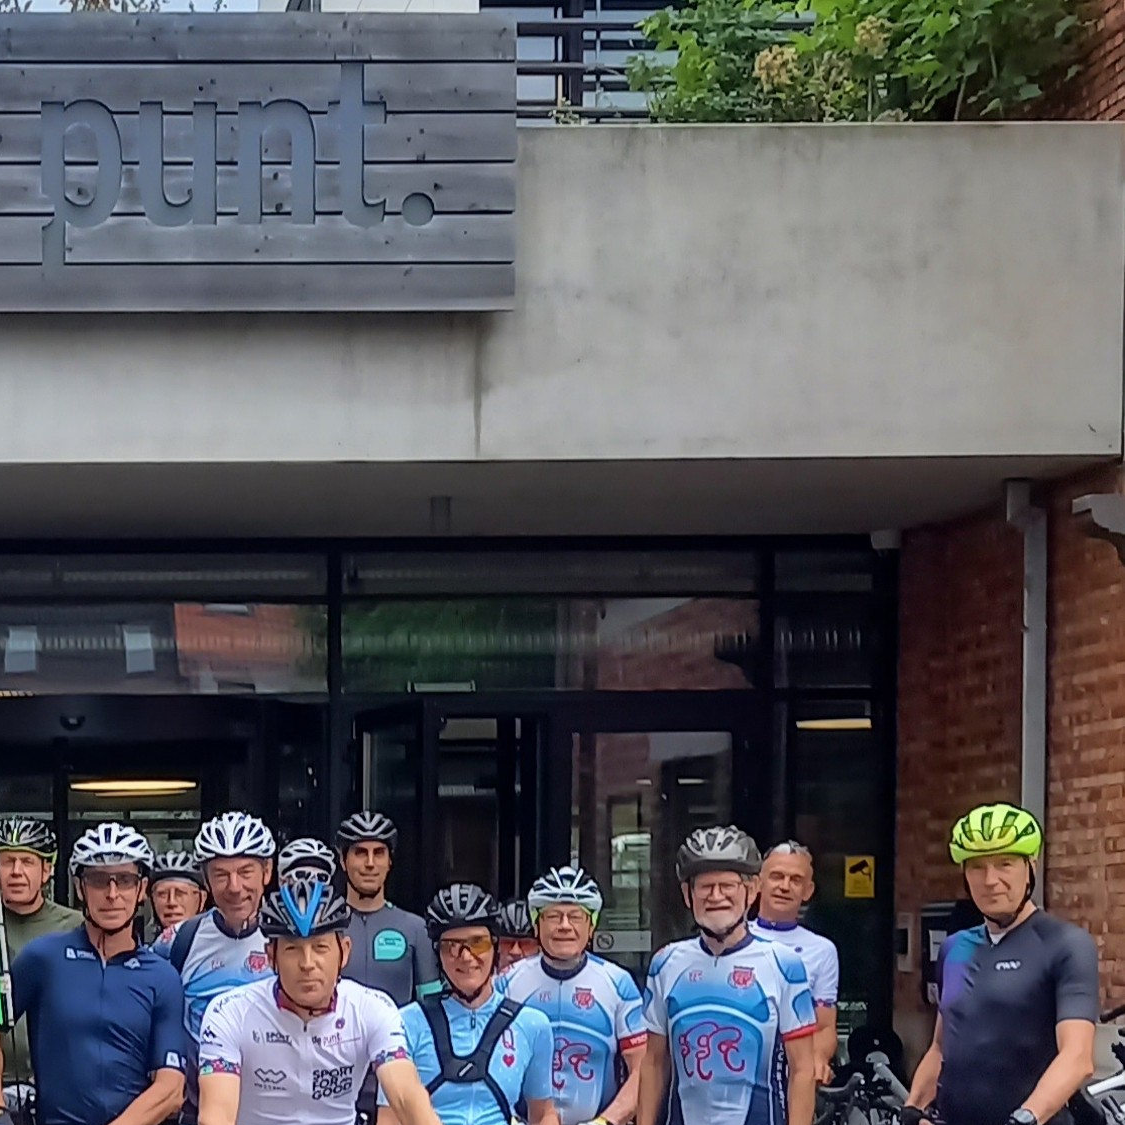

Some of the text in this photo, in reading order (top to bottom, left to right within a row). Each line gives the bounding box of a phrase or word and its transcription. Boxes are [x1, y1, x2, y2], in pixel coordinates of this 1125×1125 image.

[41, 61, 435, 277] punt.
[313, 1065, 354, 1079] SPORT
[312, 1082, 353, 1100] GOOD
[313, 1078, 339, 1091] FOR
